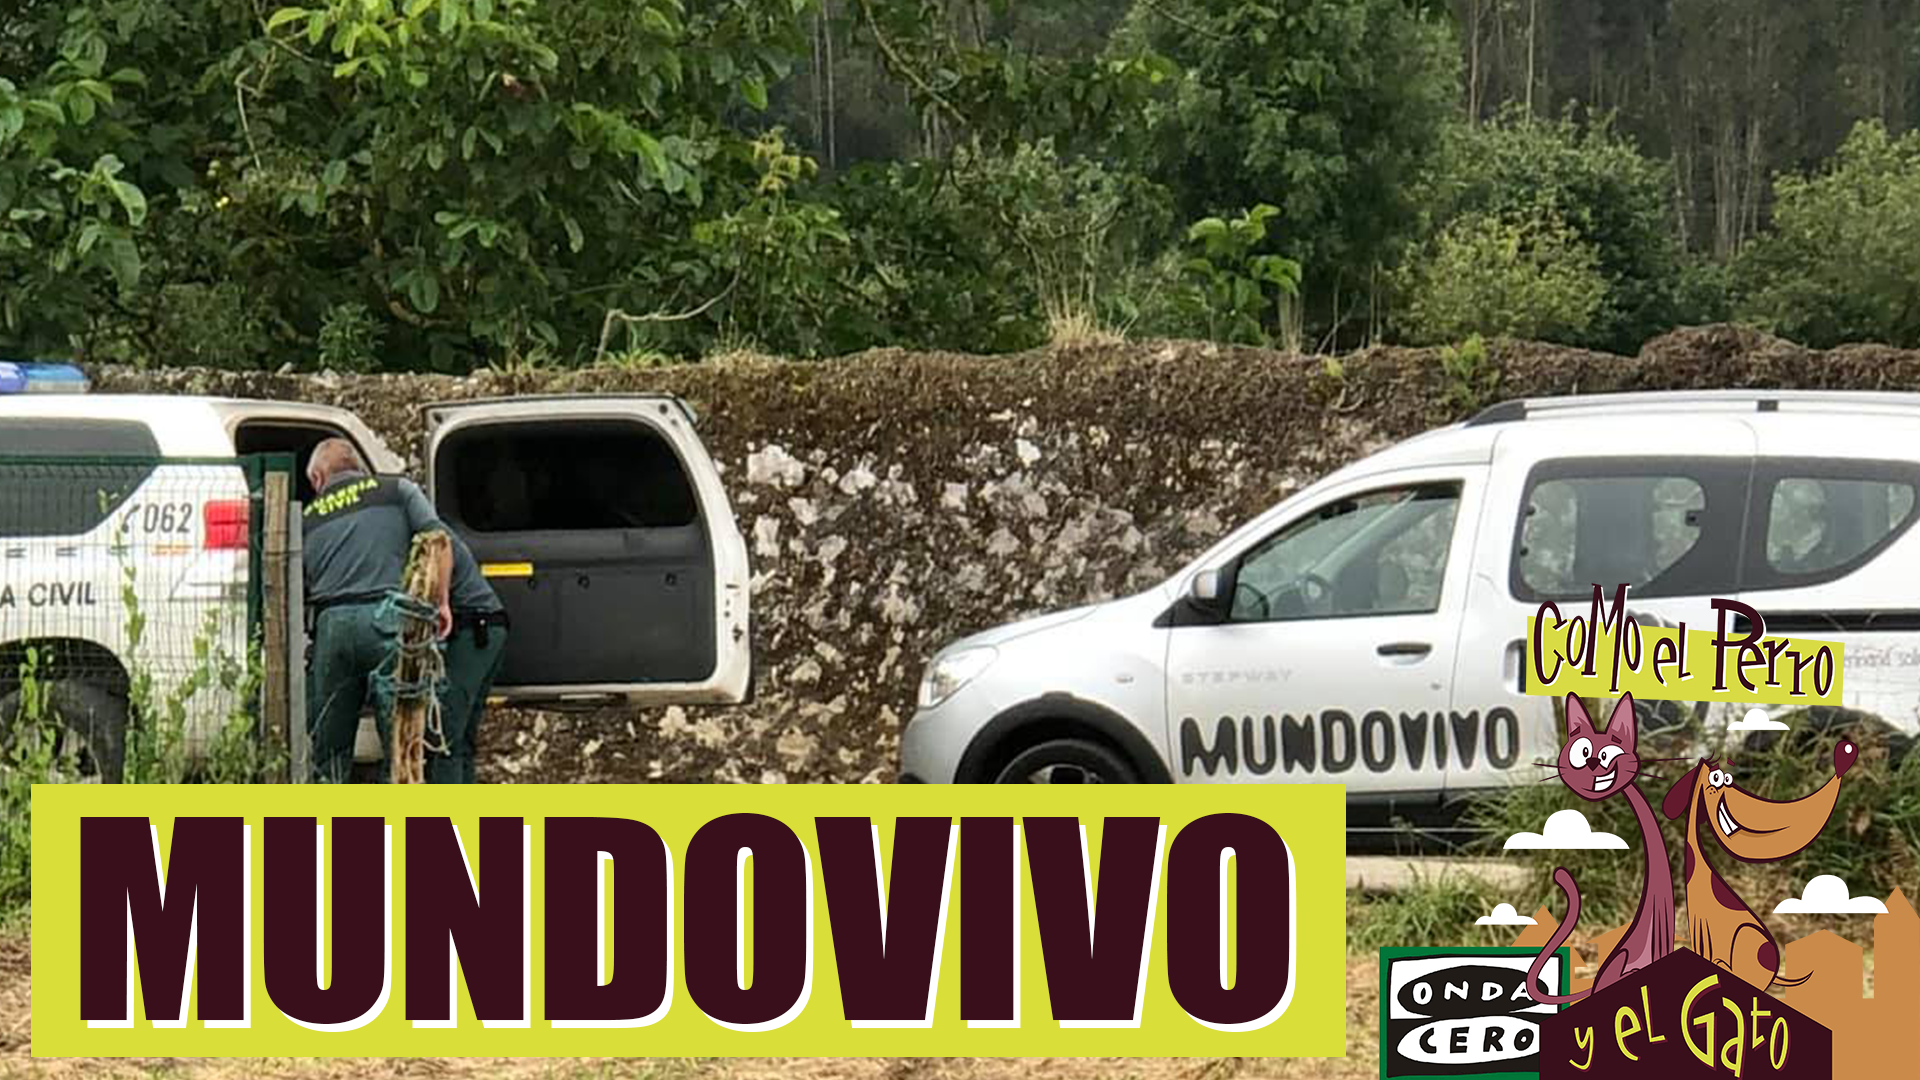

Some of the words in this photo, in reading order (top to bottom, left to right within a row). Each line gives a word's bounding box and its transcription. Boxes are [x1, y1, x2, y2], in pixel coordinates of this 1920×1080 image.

[143, 502, 193, 533] 062
[318, 495, 360, 515] CIVIL
[28, 582, 96, 608] CIVIL
[1180, 706, 1520, 777] MUNDOVIVO
